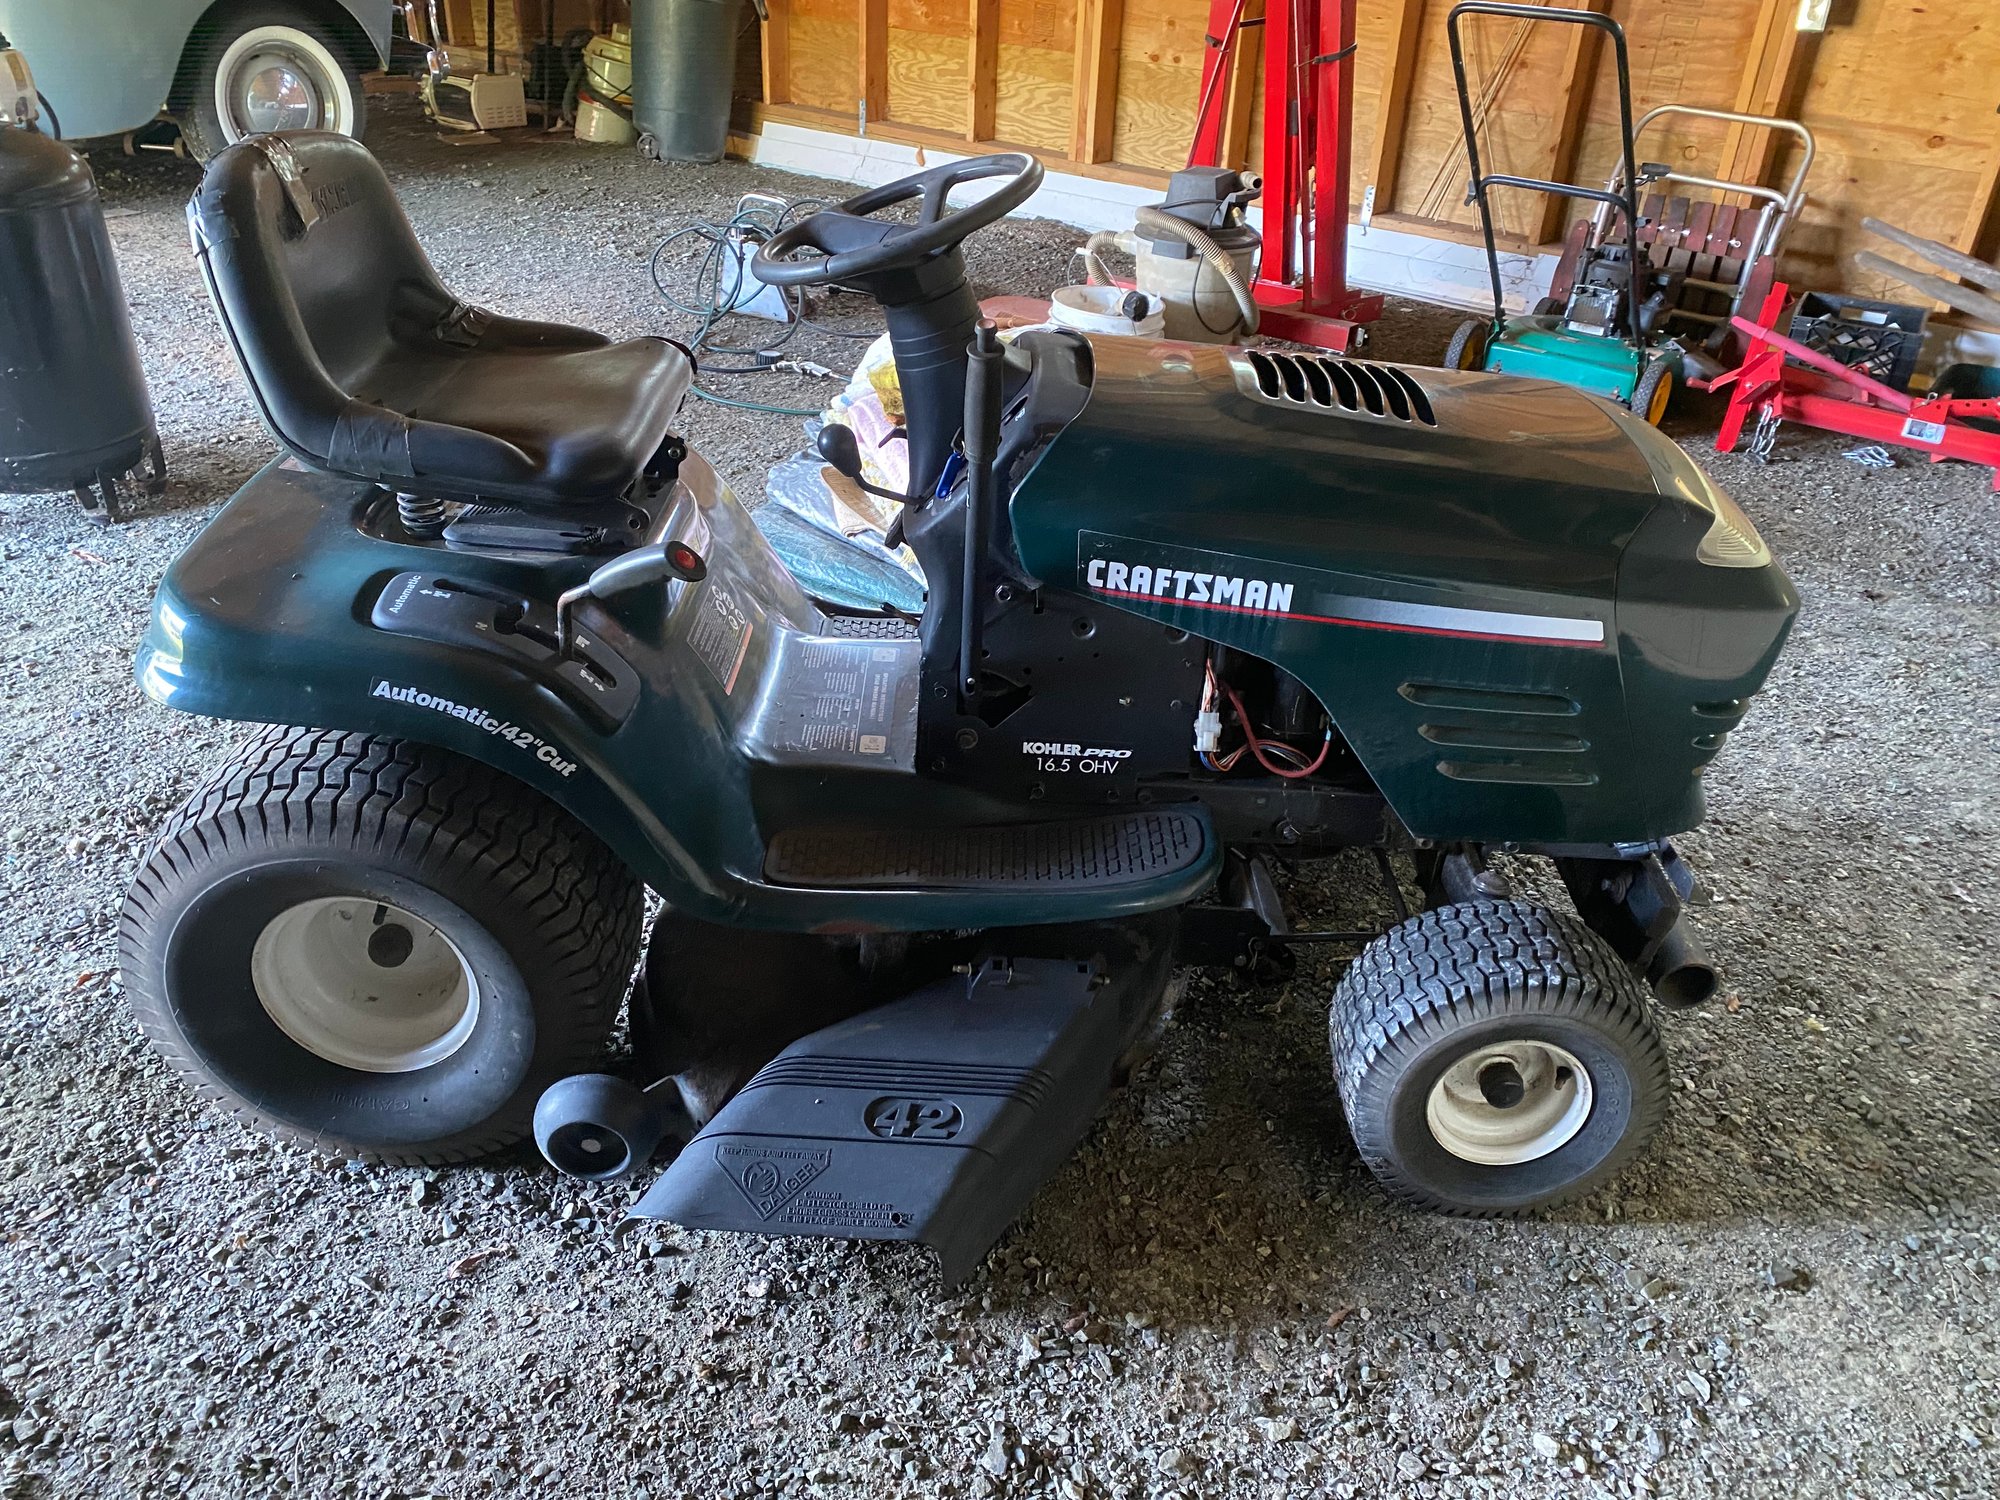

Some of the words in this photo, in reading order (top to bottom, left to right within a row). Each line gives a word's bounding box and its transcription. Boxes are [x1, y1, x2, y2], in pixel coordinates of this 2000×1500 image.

[1087, 559, 1294, 612] CRAFTSMAN
[389, 575, 422, 614] Automatic
[1022, 742, 1082, 756] KOHLER
[1082, 748, 1133, 759] PRO
[1037, 757, 1071, 772] 16.5
[1079, 759, 1120, 775] OHV
[873, 1101, 957, 1140] 42
[801, 1151, 825, 1161] AWAY
[758, 1162, 819, 1215] DANGER
[803, 1190, 842, 1200] CAUTION
[786, 1206, 818, 1216] ENTIRE
[818, 1208, 849, 1218] GRASS
[848, 1209, 889, 1220] CATCHER
[795, 1199, 848, 1210] DEFLECTOR
[803, 1216, 835, 1226] PLACE
[835, 1217, 864, 1227] WHILE
[864, 1219, 897, 1229] MOWIN
